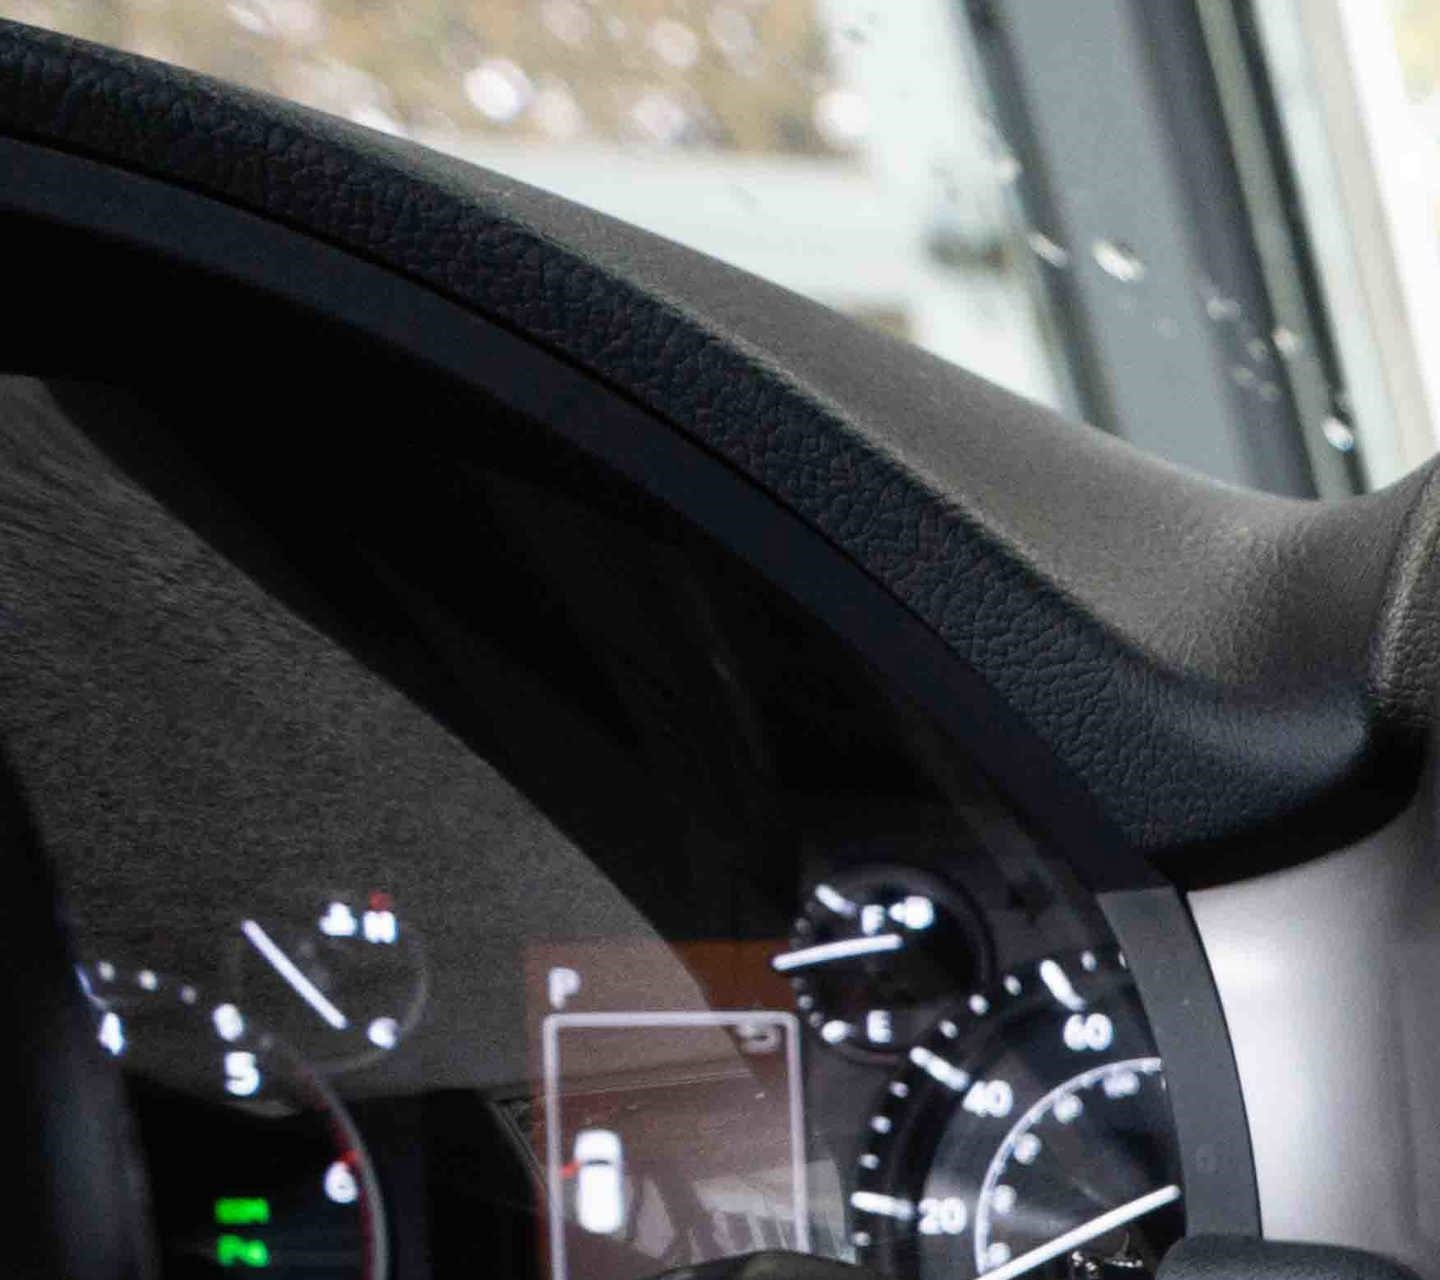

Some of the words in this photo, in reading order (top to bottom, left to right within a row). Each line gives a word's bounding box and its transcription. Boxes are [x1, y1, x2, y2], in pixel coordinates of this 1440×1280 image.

[1063, 1012, 1113, 1051] 60
[224, 1050, 261, 1096] 5
[962, 1080, 1014, 1118] 40
[918, 1197, 967, 1235] 20
